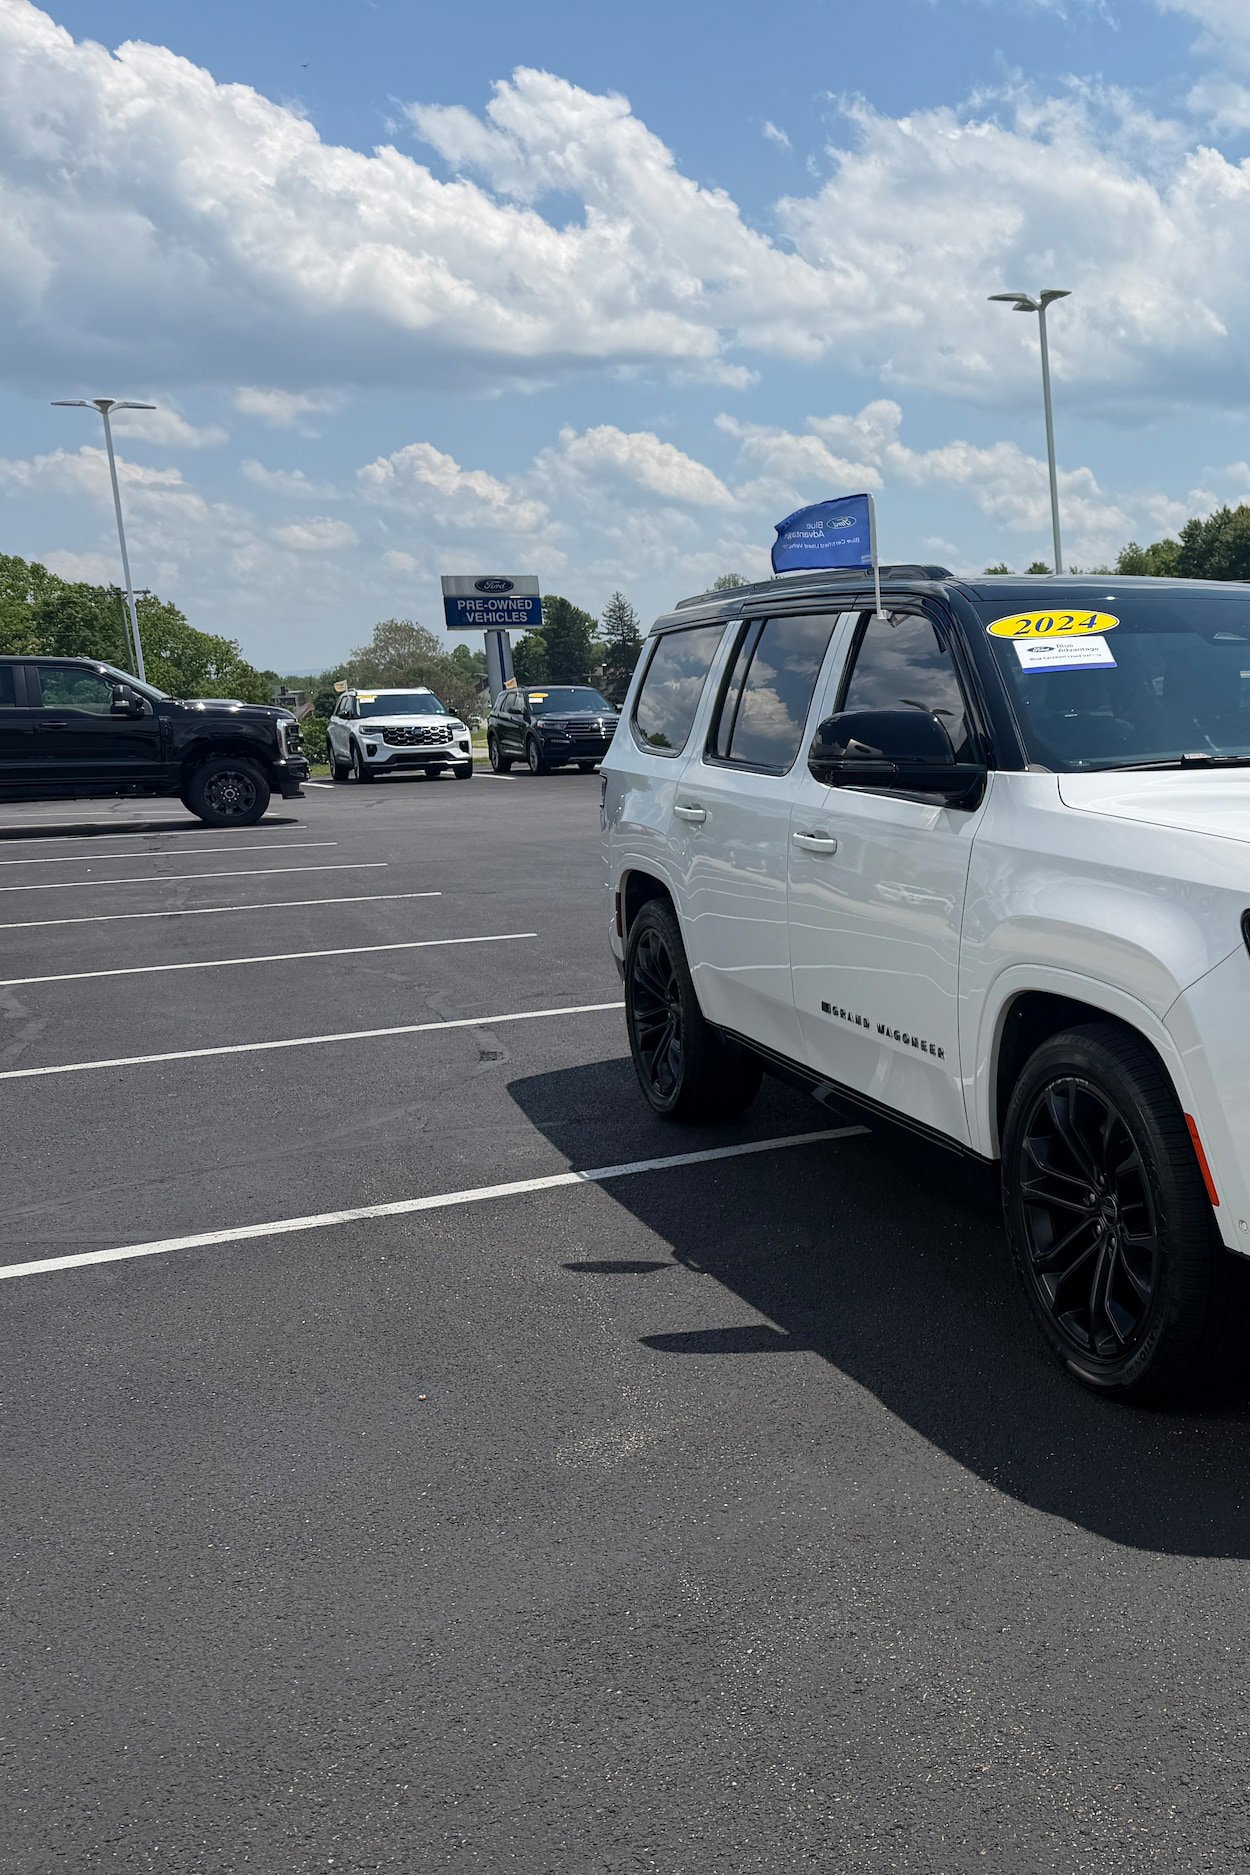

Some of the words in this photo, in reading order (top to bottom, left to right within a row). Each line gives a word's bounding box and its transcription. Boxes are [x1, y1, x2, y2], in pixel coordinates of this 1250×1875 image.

[483, 580, 506, 590] Ford
[457, 600, 533, 611] PRE-OWNED
[466, 612, 528, 623] VEHICLES
[1013, 614, 1098, 635] 2024
[832, 1005, 870, 1029] GRAND
[876, 1022, 945, 1060] WAGONEER
